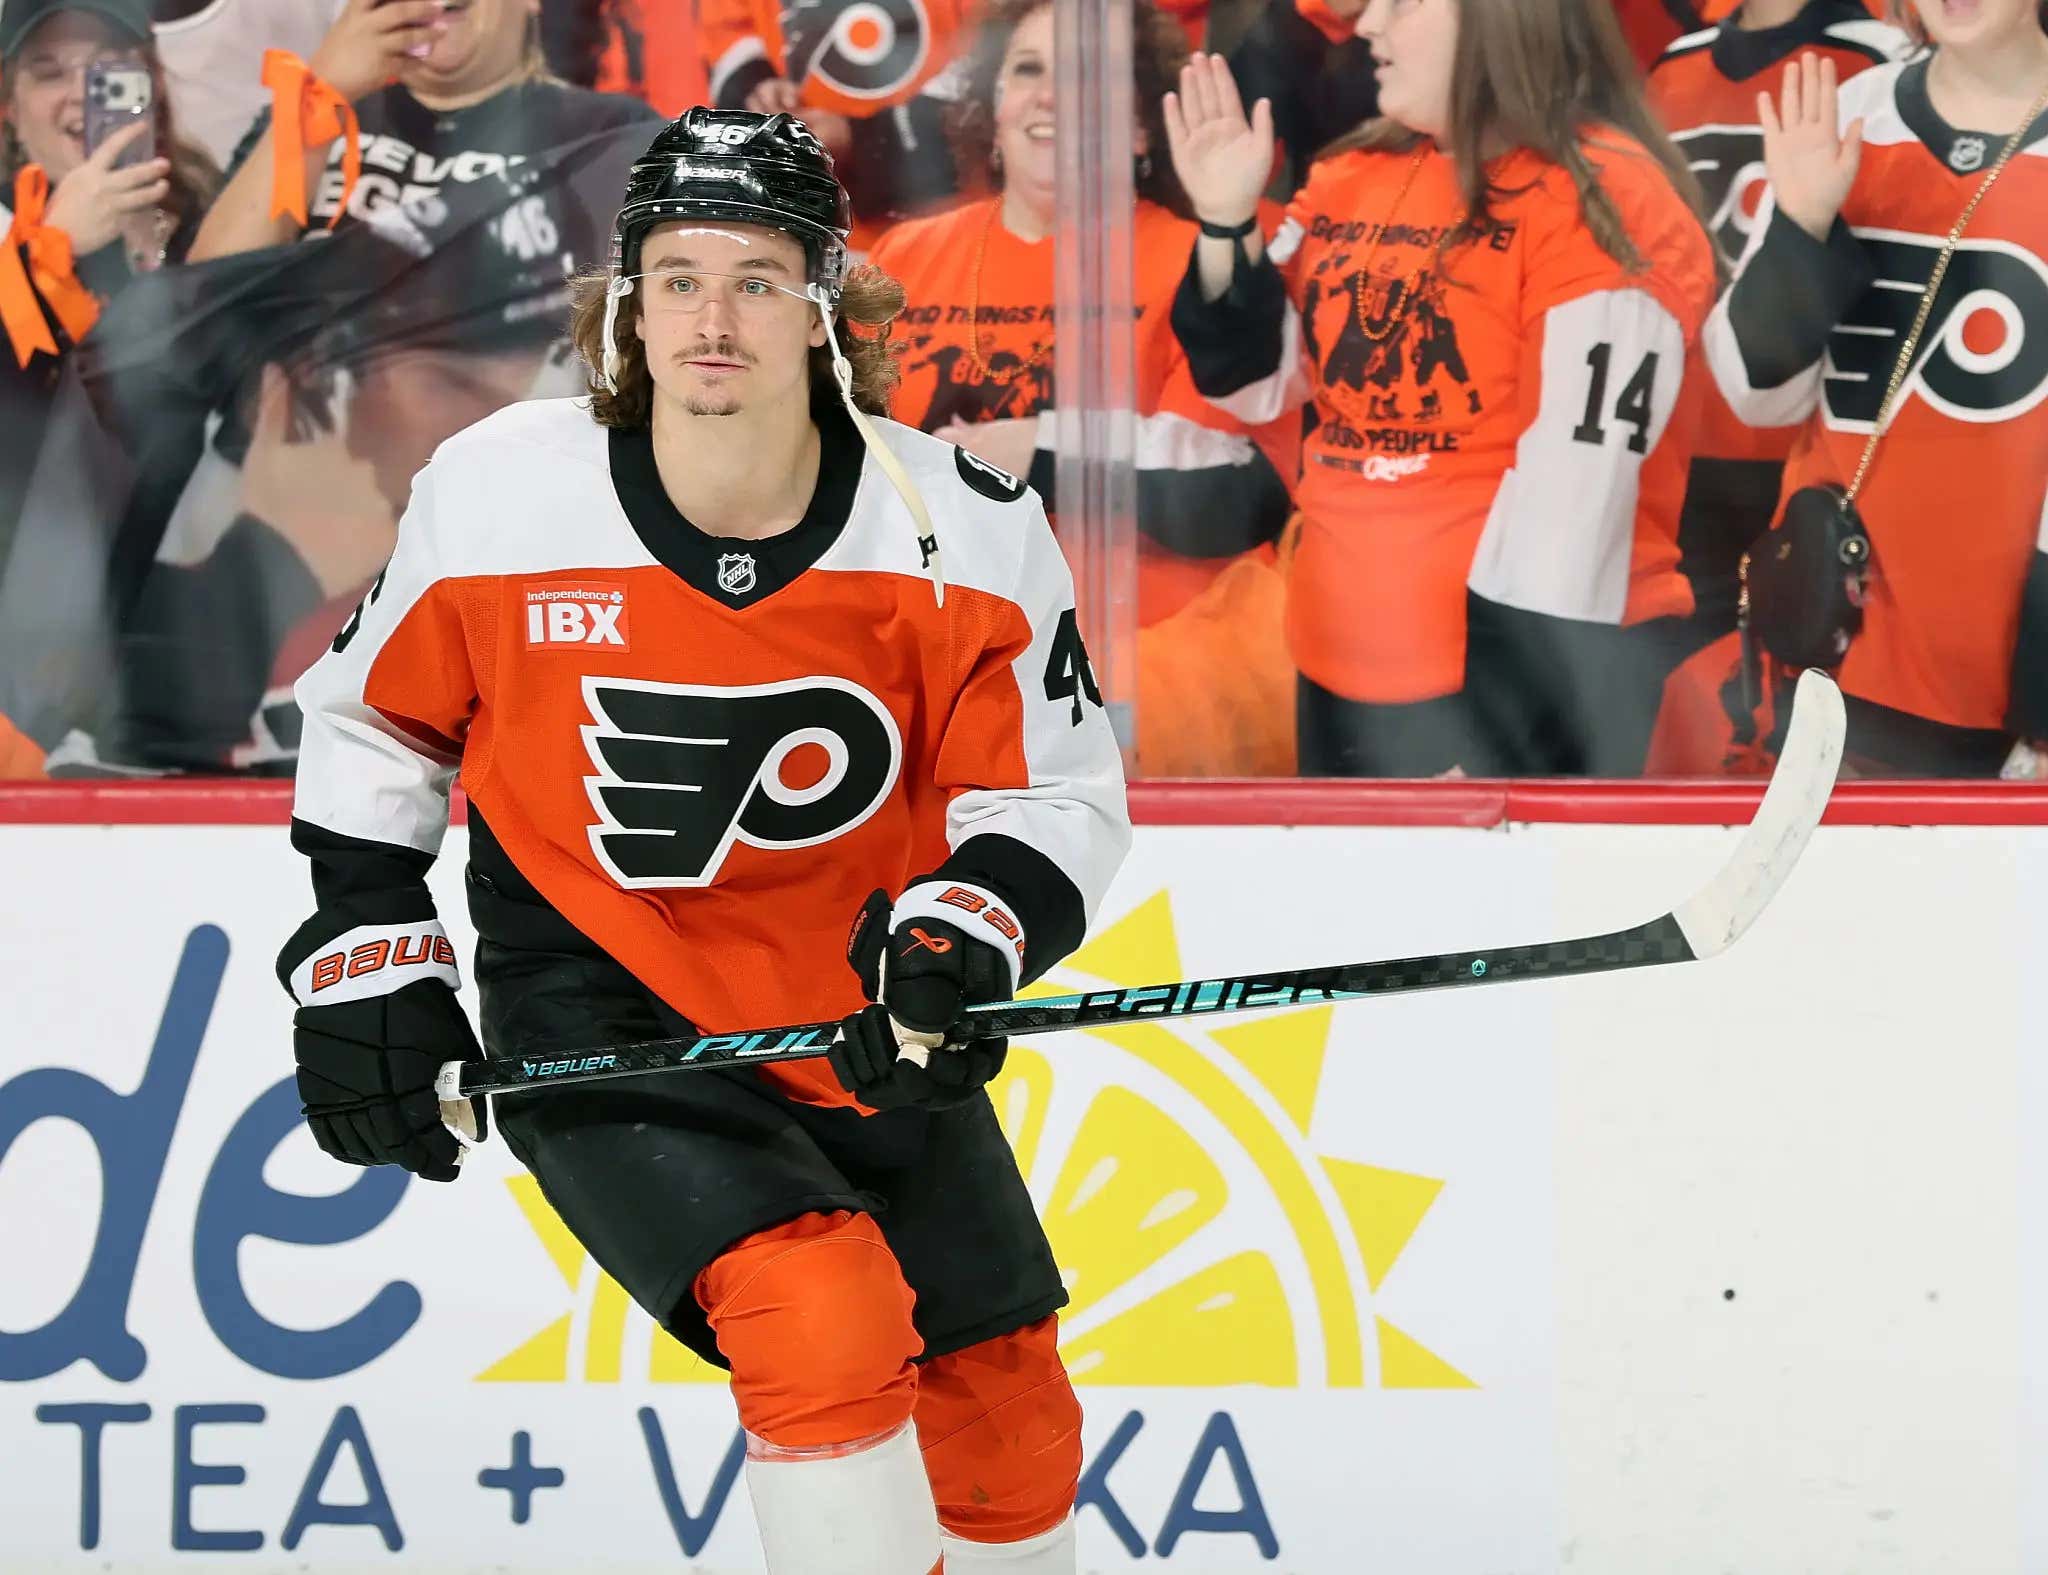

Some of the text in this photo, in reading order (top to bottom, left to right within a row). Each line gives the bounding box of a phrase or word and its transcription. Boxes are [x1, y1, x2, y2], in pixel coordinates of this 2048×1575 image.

[1573, 342, 1660, 455] 14
[1366, 428, 1459, 453] PEOPLE
[726, 564, 749, 586] NHL
[527, 589, 609, 601] Independence
[527, 602, 626, 646] IBX
[311, 933, 457, 994] BAUE
[679, 1029, 834, 1061] PUL
[35, 1402, 405, 1552] TEA
[637, 1405, 1281, 1560] VKA
